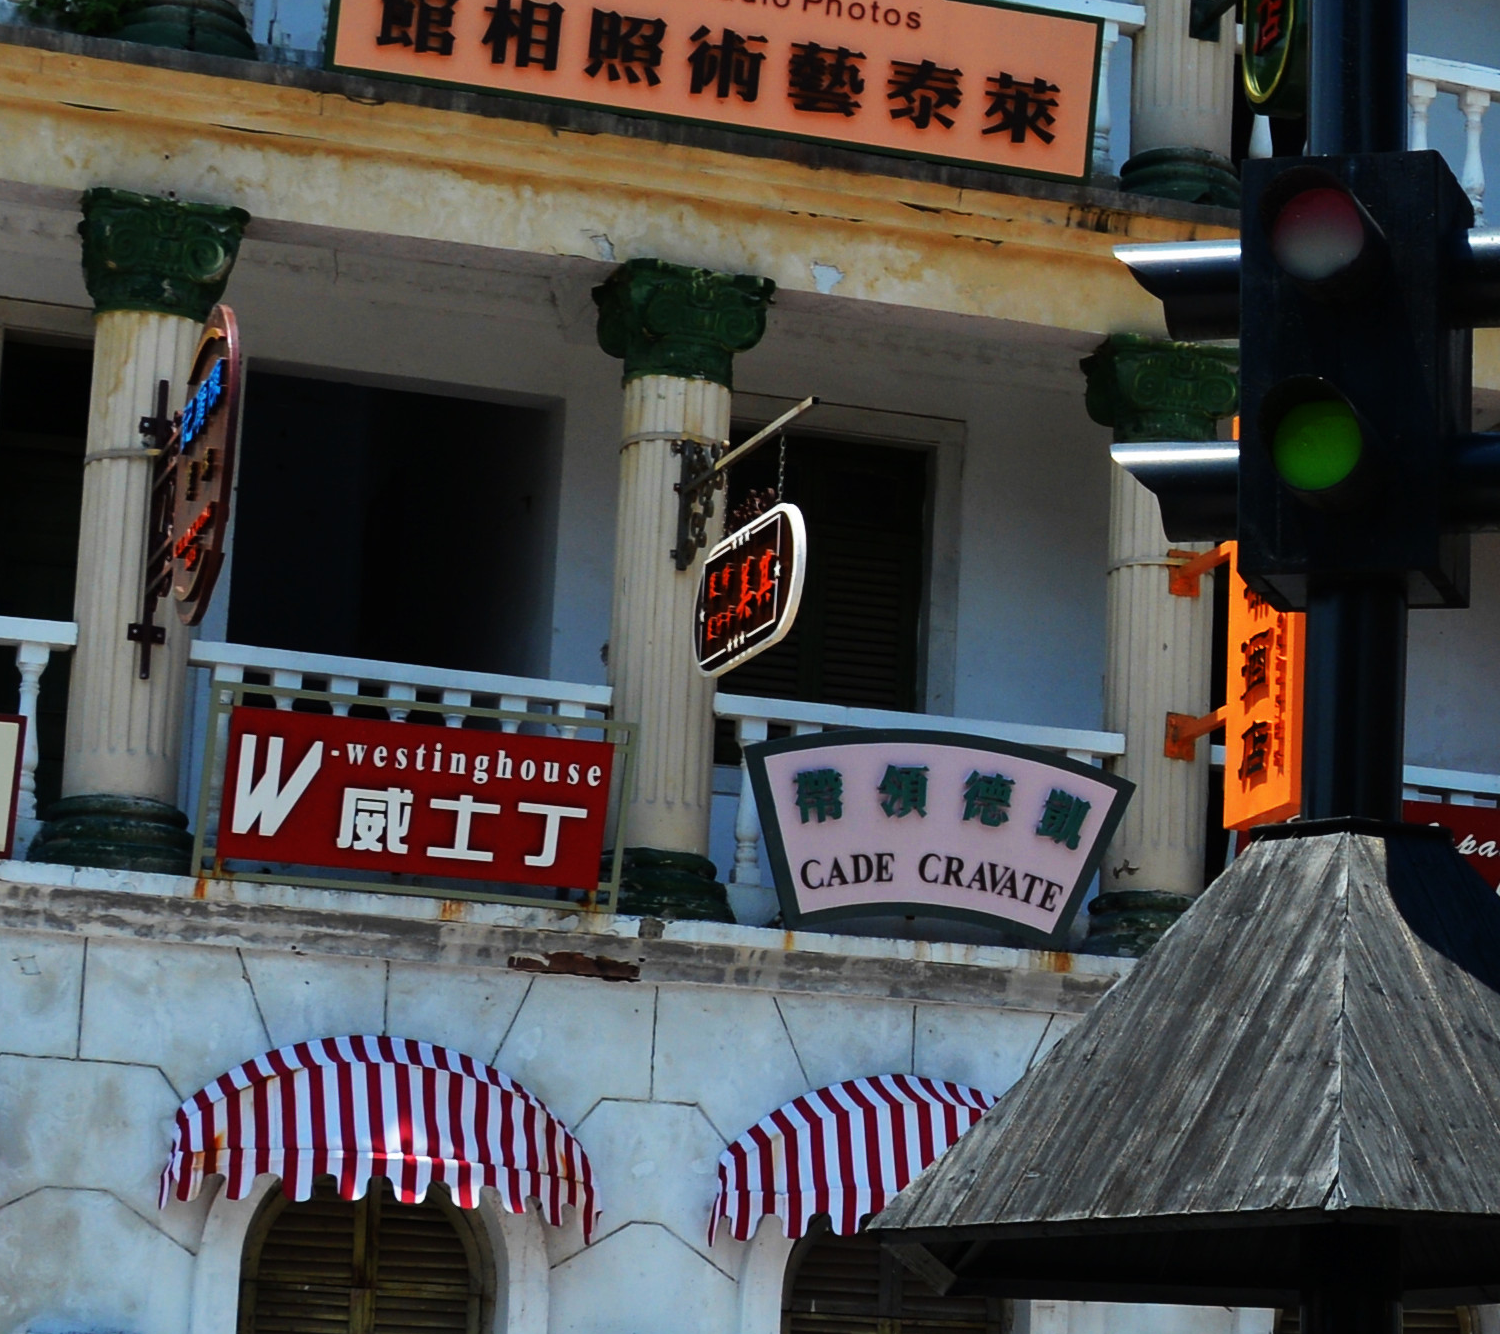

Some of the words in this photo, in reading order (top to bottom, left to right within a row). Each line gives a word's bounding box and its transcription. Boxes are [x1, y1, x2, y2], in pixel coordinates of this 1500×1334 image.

[336, 786, 588, 869] 威士丁
[800, 852, 895, 890] CADE
[918, 853, 1064, 913] CRAVATE
